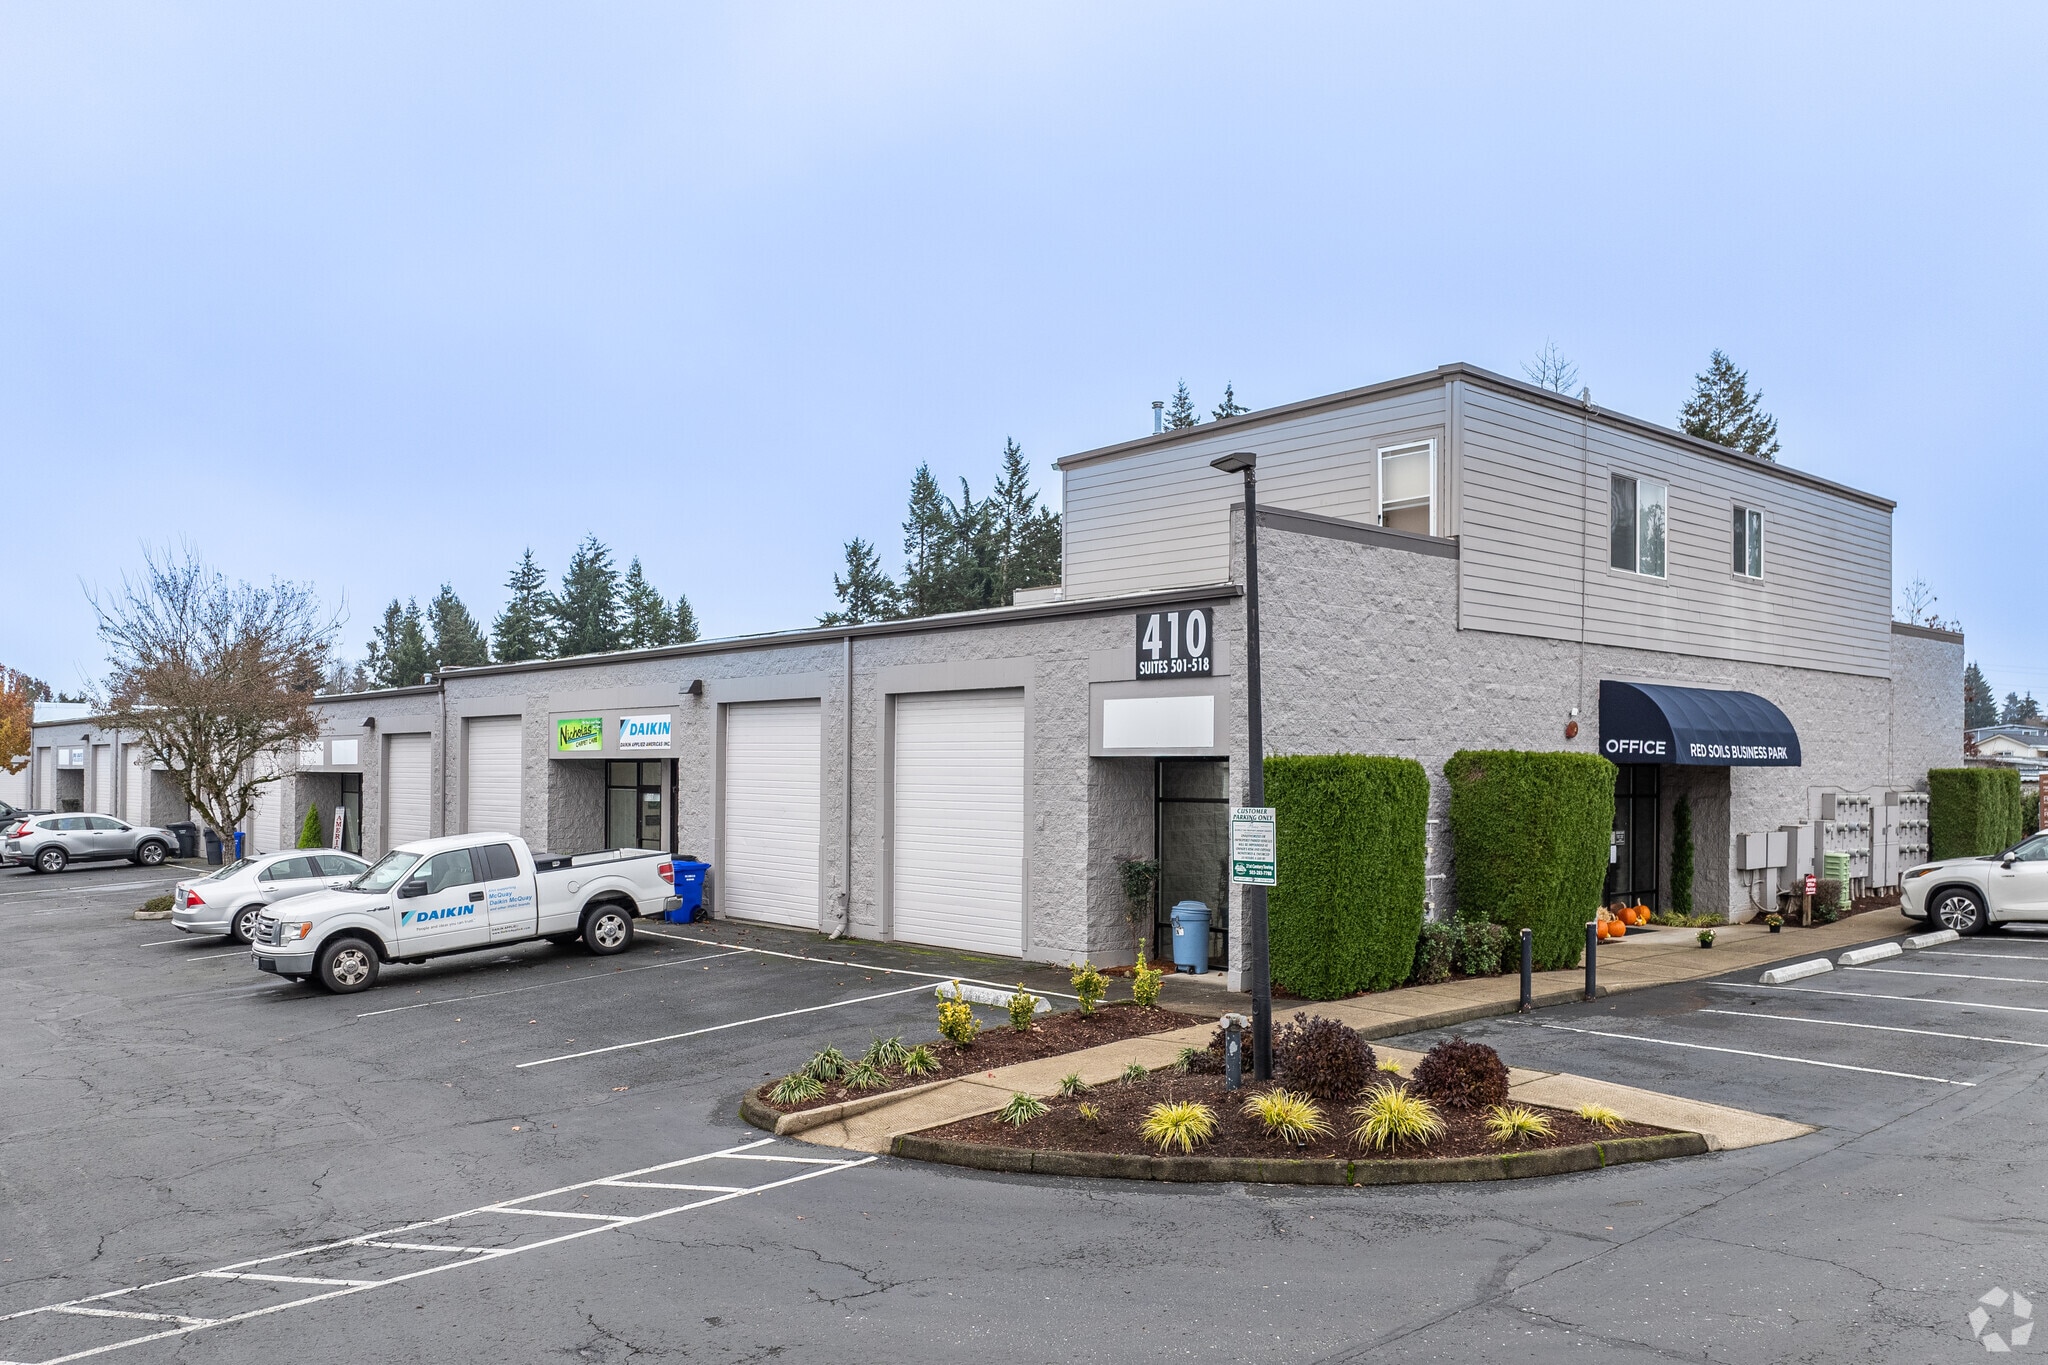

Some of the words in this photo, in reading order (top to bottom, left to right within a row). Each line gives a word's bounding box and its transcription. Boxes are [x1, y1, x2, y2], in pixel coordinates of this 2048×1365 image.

[1142, 609, 1207, 660] 410
[1139, 660, 1169, 675] SUITES
[1170, 656, 1210, 673] 501-518
[560, 724, 592, 747] Nicholas
[630, 721, 671, 735] DAIKIN
[1605, 738, 1667, 755] OFFICE
[1689, 743, 1707, 757] RED
[1707, 744, 1731, 759] SOILS
[1731, 745, 1768, 759] BUSINESS
[1768, 746, 1788, 760] PARK
[417, 904, 474, 922] DAIKIN
